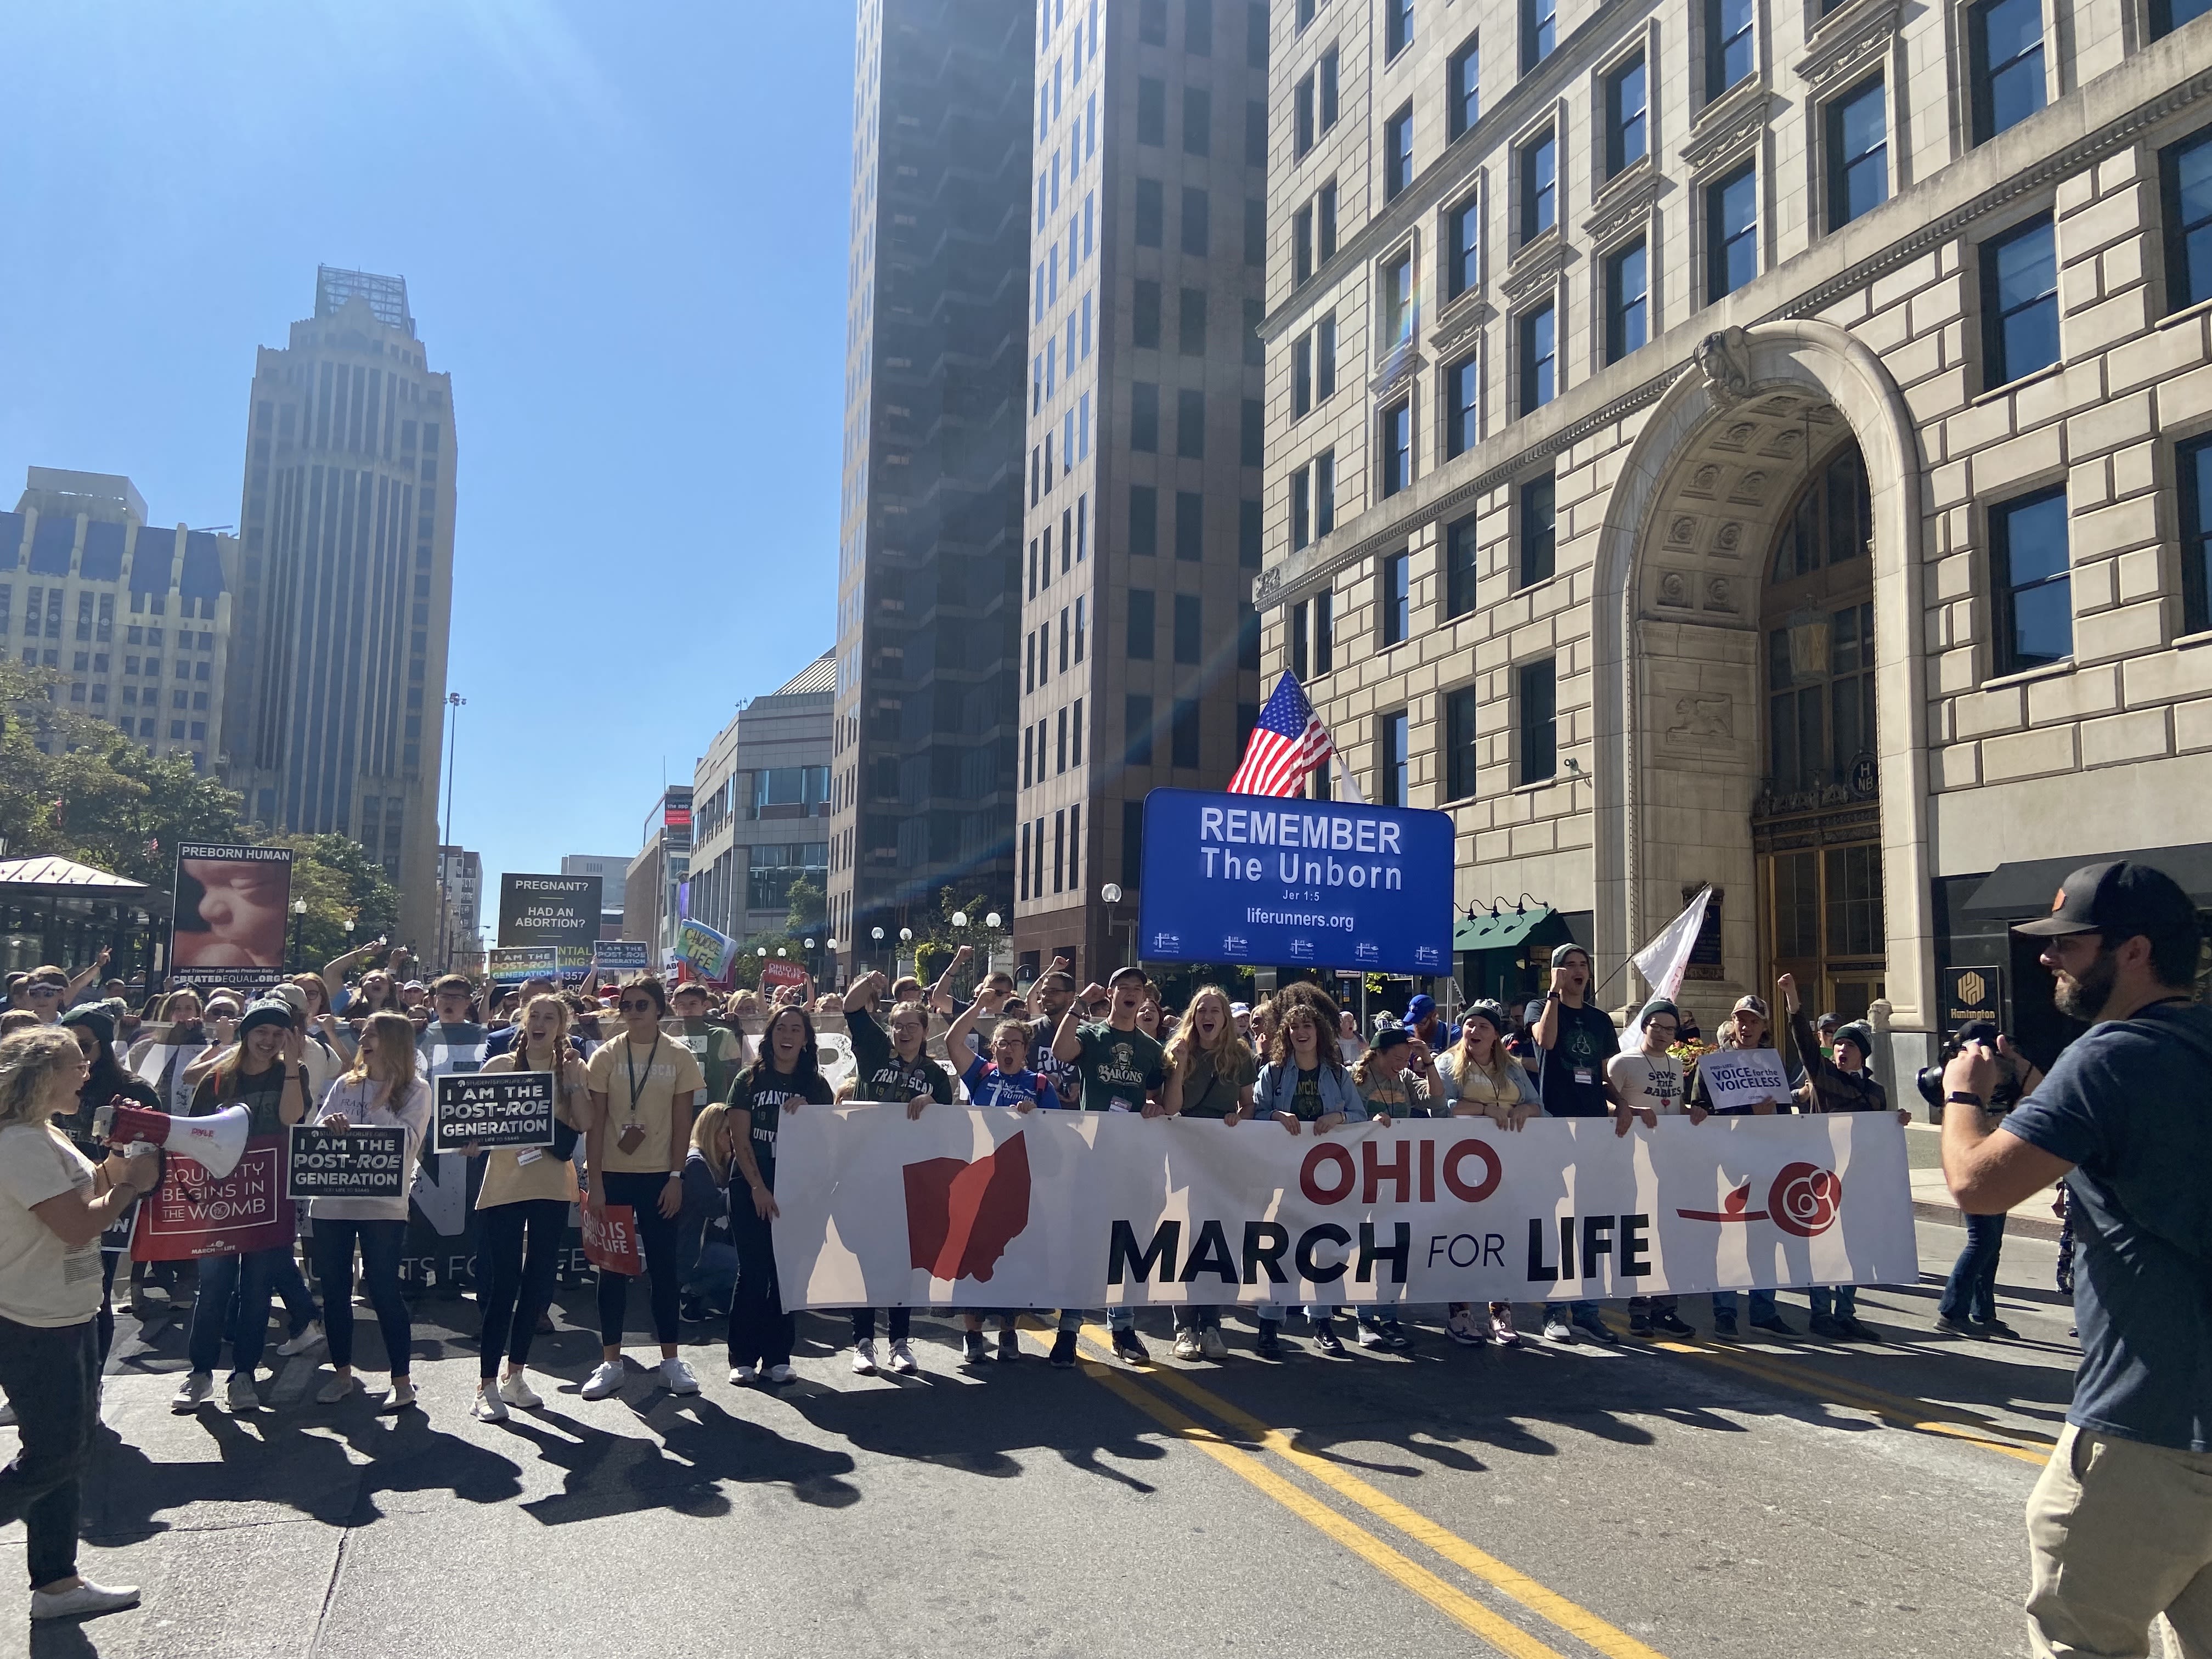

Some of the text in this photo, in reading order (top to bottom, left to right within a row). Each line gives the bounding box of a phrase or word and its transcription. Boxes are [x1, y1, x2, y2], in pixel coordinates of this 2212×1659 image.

[1861, 763, 1870, 777] H
[1859, 776, 1873, 791] NB
[1200, 806, 1401, 854] REMEMBER
[182, 847, 290, 860] PREBORN HUMAN
[1201, 847, 1402, 890] The Unborn
[516, 880, 589, 891] PREGNANT?
[1283, 889, 1320, 901] Jer 1:5
[528, 907, 574, 917] HAD AN
[1247, 907, 1355, 932] liferunners.org
[515, 918, 586, 928] ABORTION?
[492, 961, 555, 970] POST-ROE
[493, 970, 553, 979] GENERATION
[1951, 1008, 1995, 1020] Huntington
[1648, 1071, 1677, 1081] SAVE
[1712, 1067, 1752, 1081] VOICE
[1643, 1086, 1681, 1097] BABIES
[1716, 1077, 1781, 1092] VOICELESS
[447, 1085, 543, 1101] I AM THE
[441, 1099, 551, 1120] POST-ROE
[443, 1119, 547, 1137] GENERATION
[300, 1138, 396, 1151] I AM THE
[294, 1153, 402, 1169] POST-ROE
[295, 1172, 398, 1186] GENERATION
[1300, 1138, 1502, 1206] OHIO
[162, 1180, 264, 1202] BEGINS IN
[163, 1198, 266, 1220] THE WOMB
[583, 1210, 627, 1240] OHIO IS
[584, 1231, 629, 1254] PRO-LIFE
[1107, 1214, 1651, 1285] MARCH FOR LIFE
